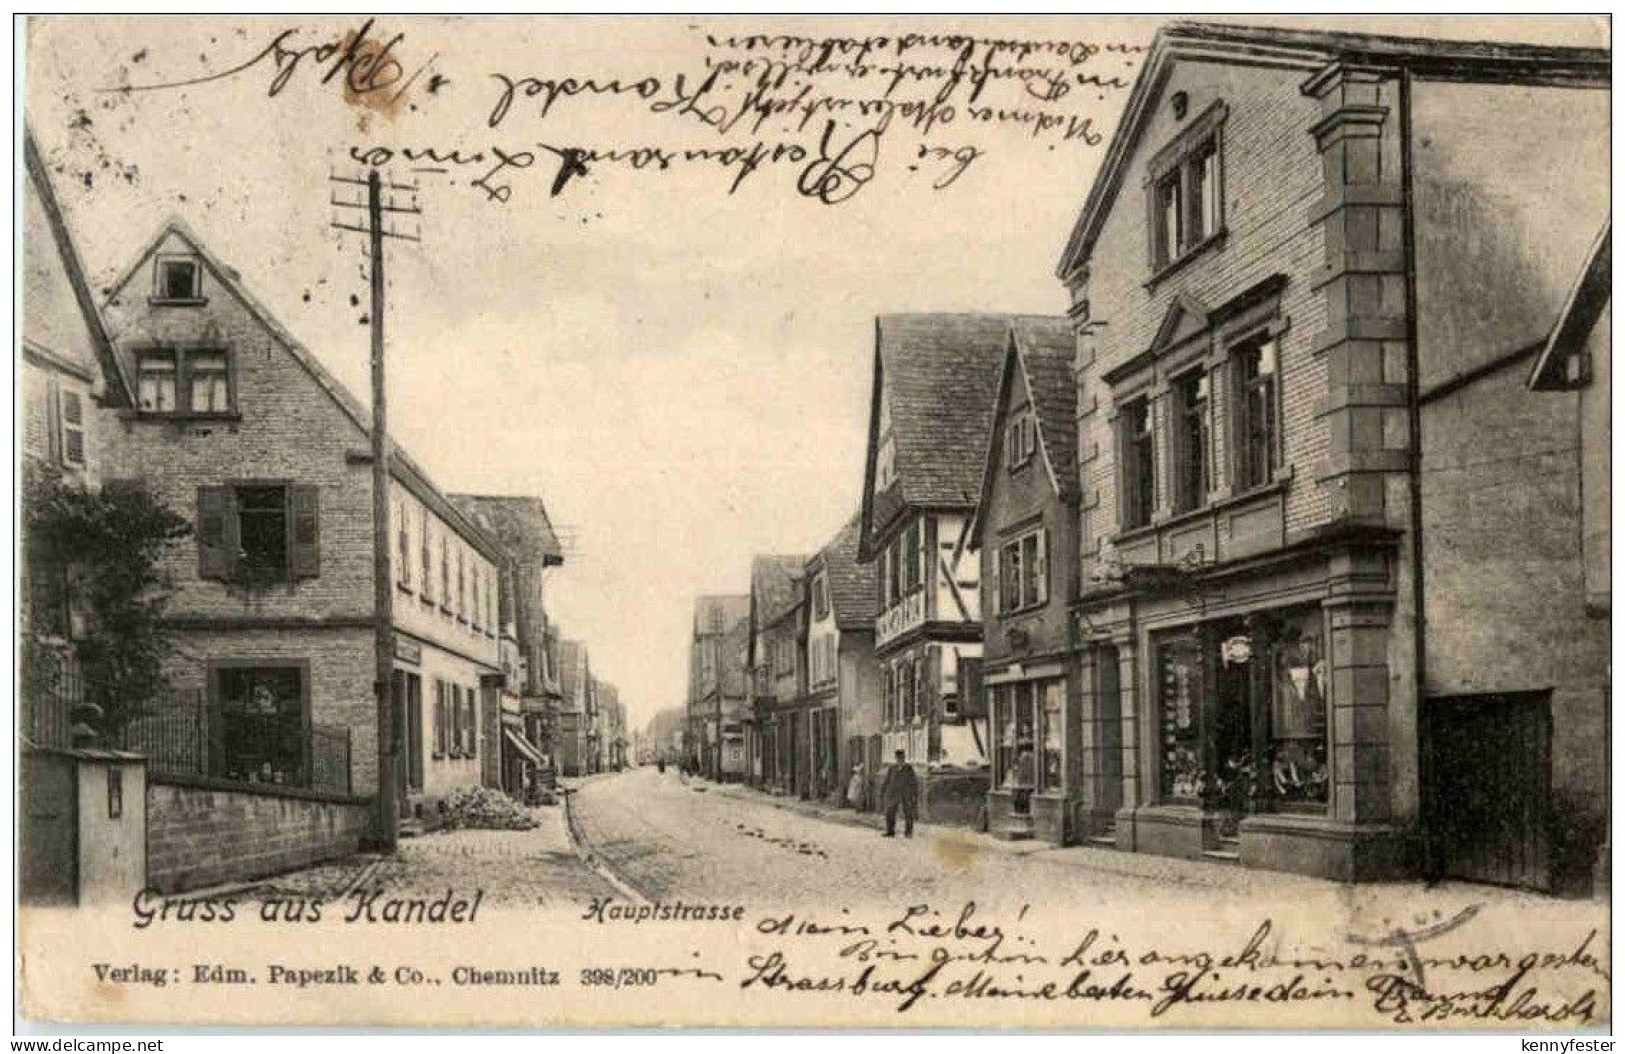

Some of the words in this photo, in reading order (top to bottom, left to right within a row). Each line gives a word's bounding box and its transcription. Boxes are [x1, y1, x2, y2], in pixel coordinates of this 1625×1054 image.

[132, 887, 238, 928] Gruss
[260, 896, 323, 922] aus
[344, 888, 484, 922] Kandel
[581, 897, 745, 924] Hauptstrasse
[193, 965, 256, 984] Edm.
[267, 965, 358, 987] Papezik
[367, 966, 386, 984] &
[452, 967, 561, 985] Chemnitz
[580, 968, 657, 987] 398/200
